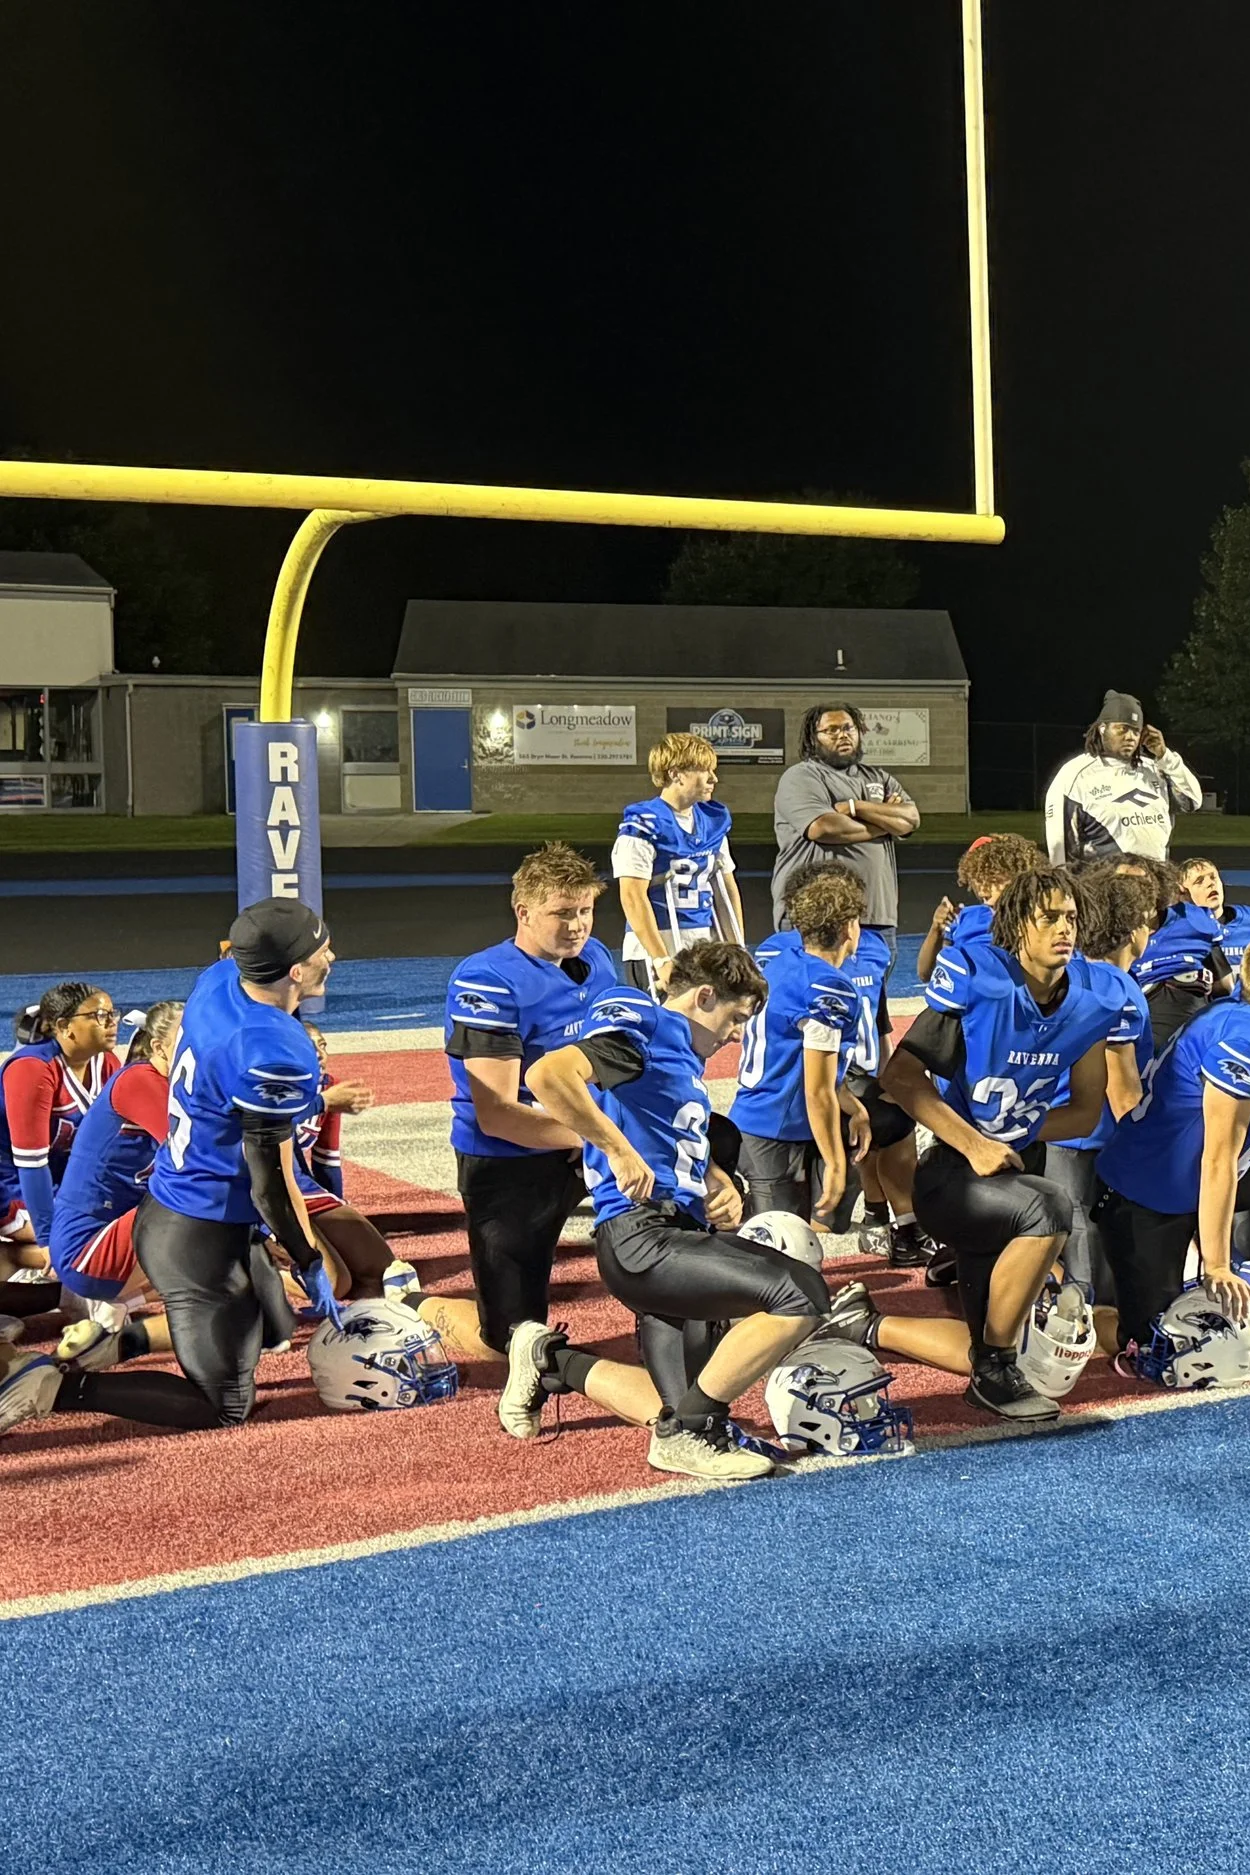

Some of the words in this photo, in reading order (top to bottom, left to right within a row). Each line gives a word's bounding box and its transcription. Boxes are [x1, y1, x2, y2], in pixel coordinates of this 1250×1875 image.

[541, 710, 632, 730] Longmeadow
[692, 726, 729, 738] PRINT
[731, 726, 761, 738] SIGN
[1007, 1050, 1060, 1066] RAVENNA
